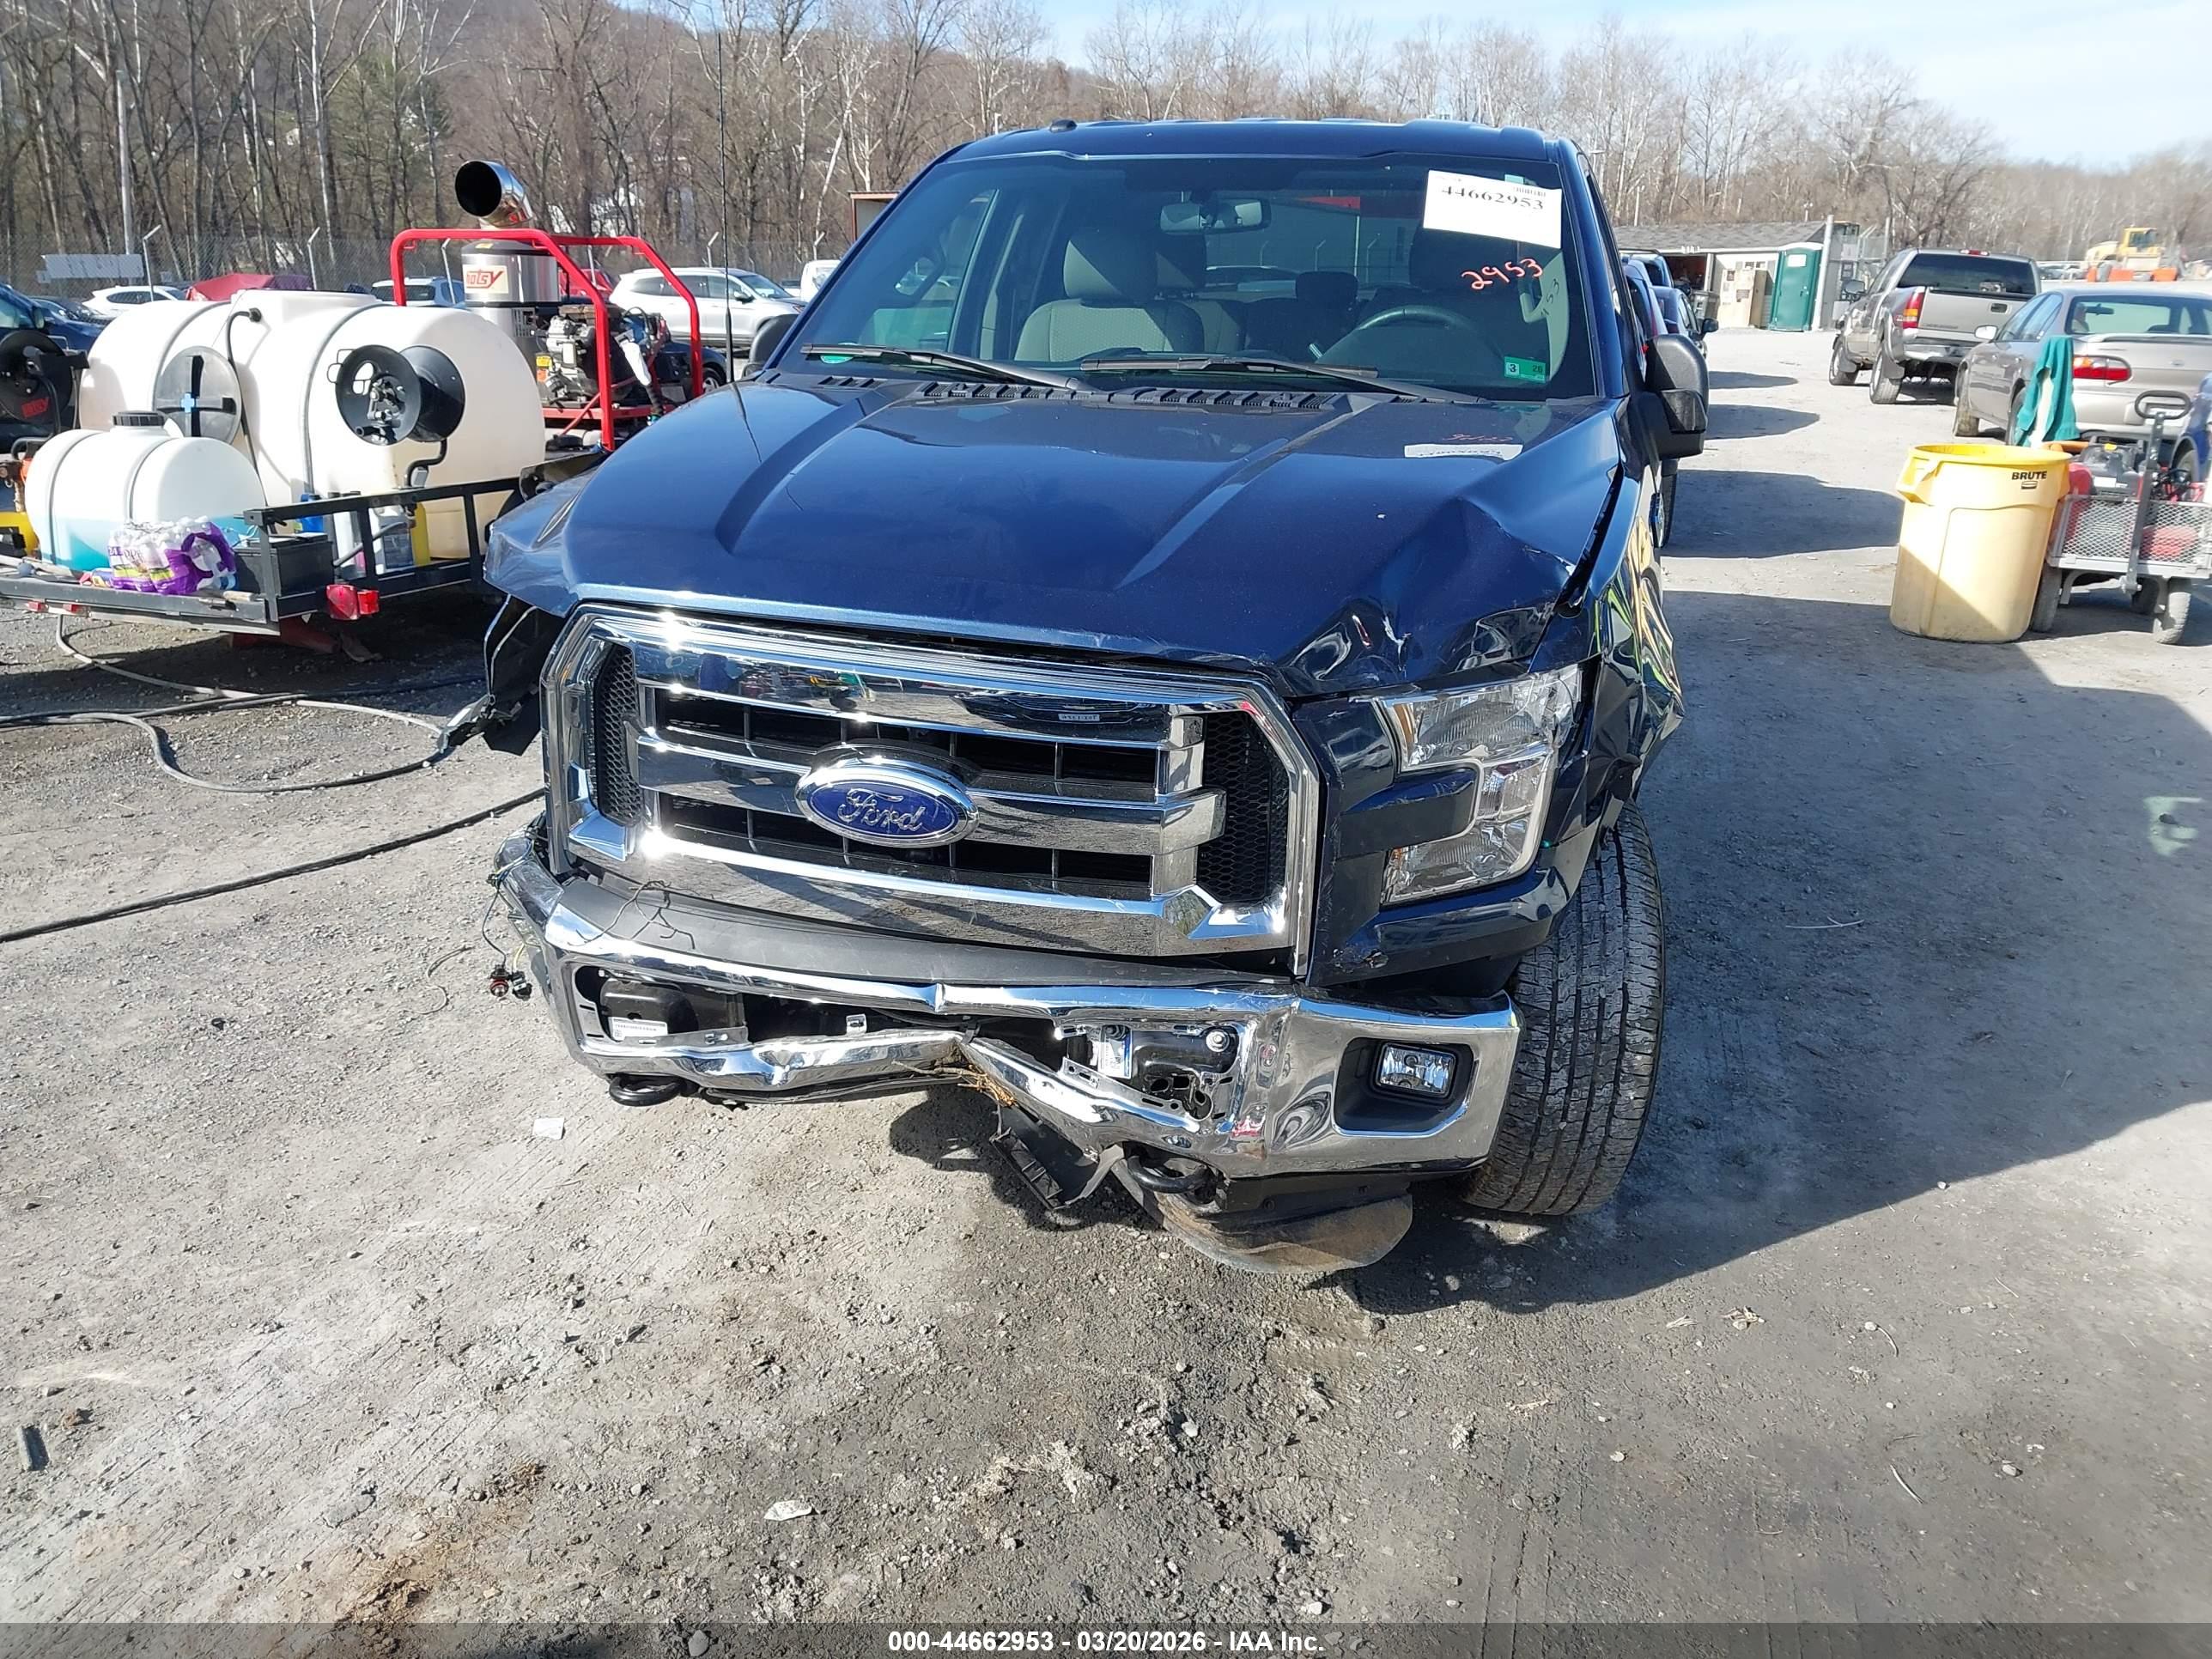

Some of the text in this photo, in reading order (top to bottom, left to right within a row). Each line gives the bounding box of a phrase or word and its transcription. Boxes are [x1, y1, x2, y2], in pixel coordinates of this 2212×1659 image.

[1441, 185, 1544, 210] 44662953
[1461, 258, 1544, 290] 2953
[1509, 363, 1517, 373] 3
[2011, 471, 2048, 480] BRUTE
[837, 787, 927, 831] Ford
